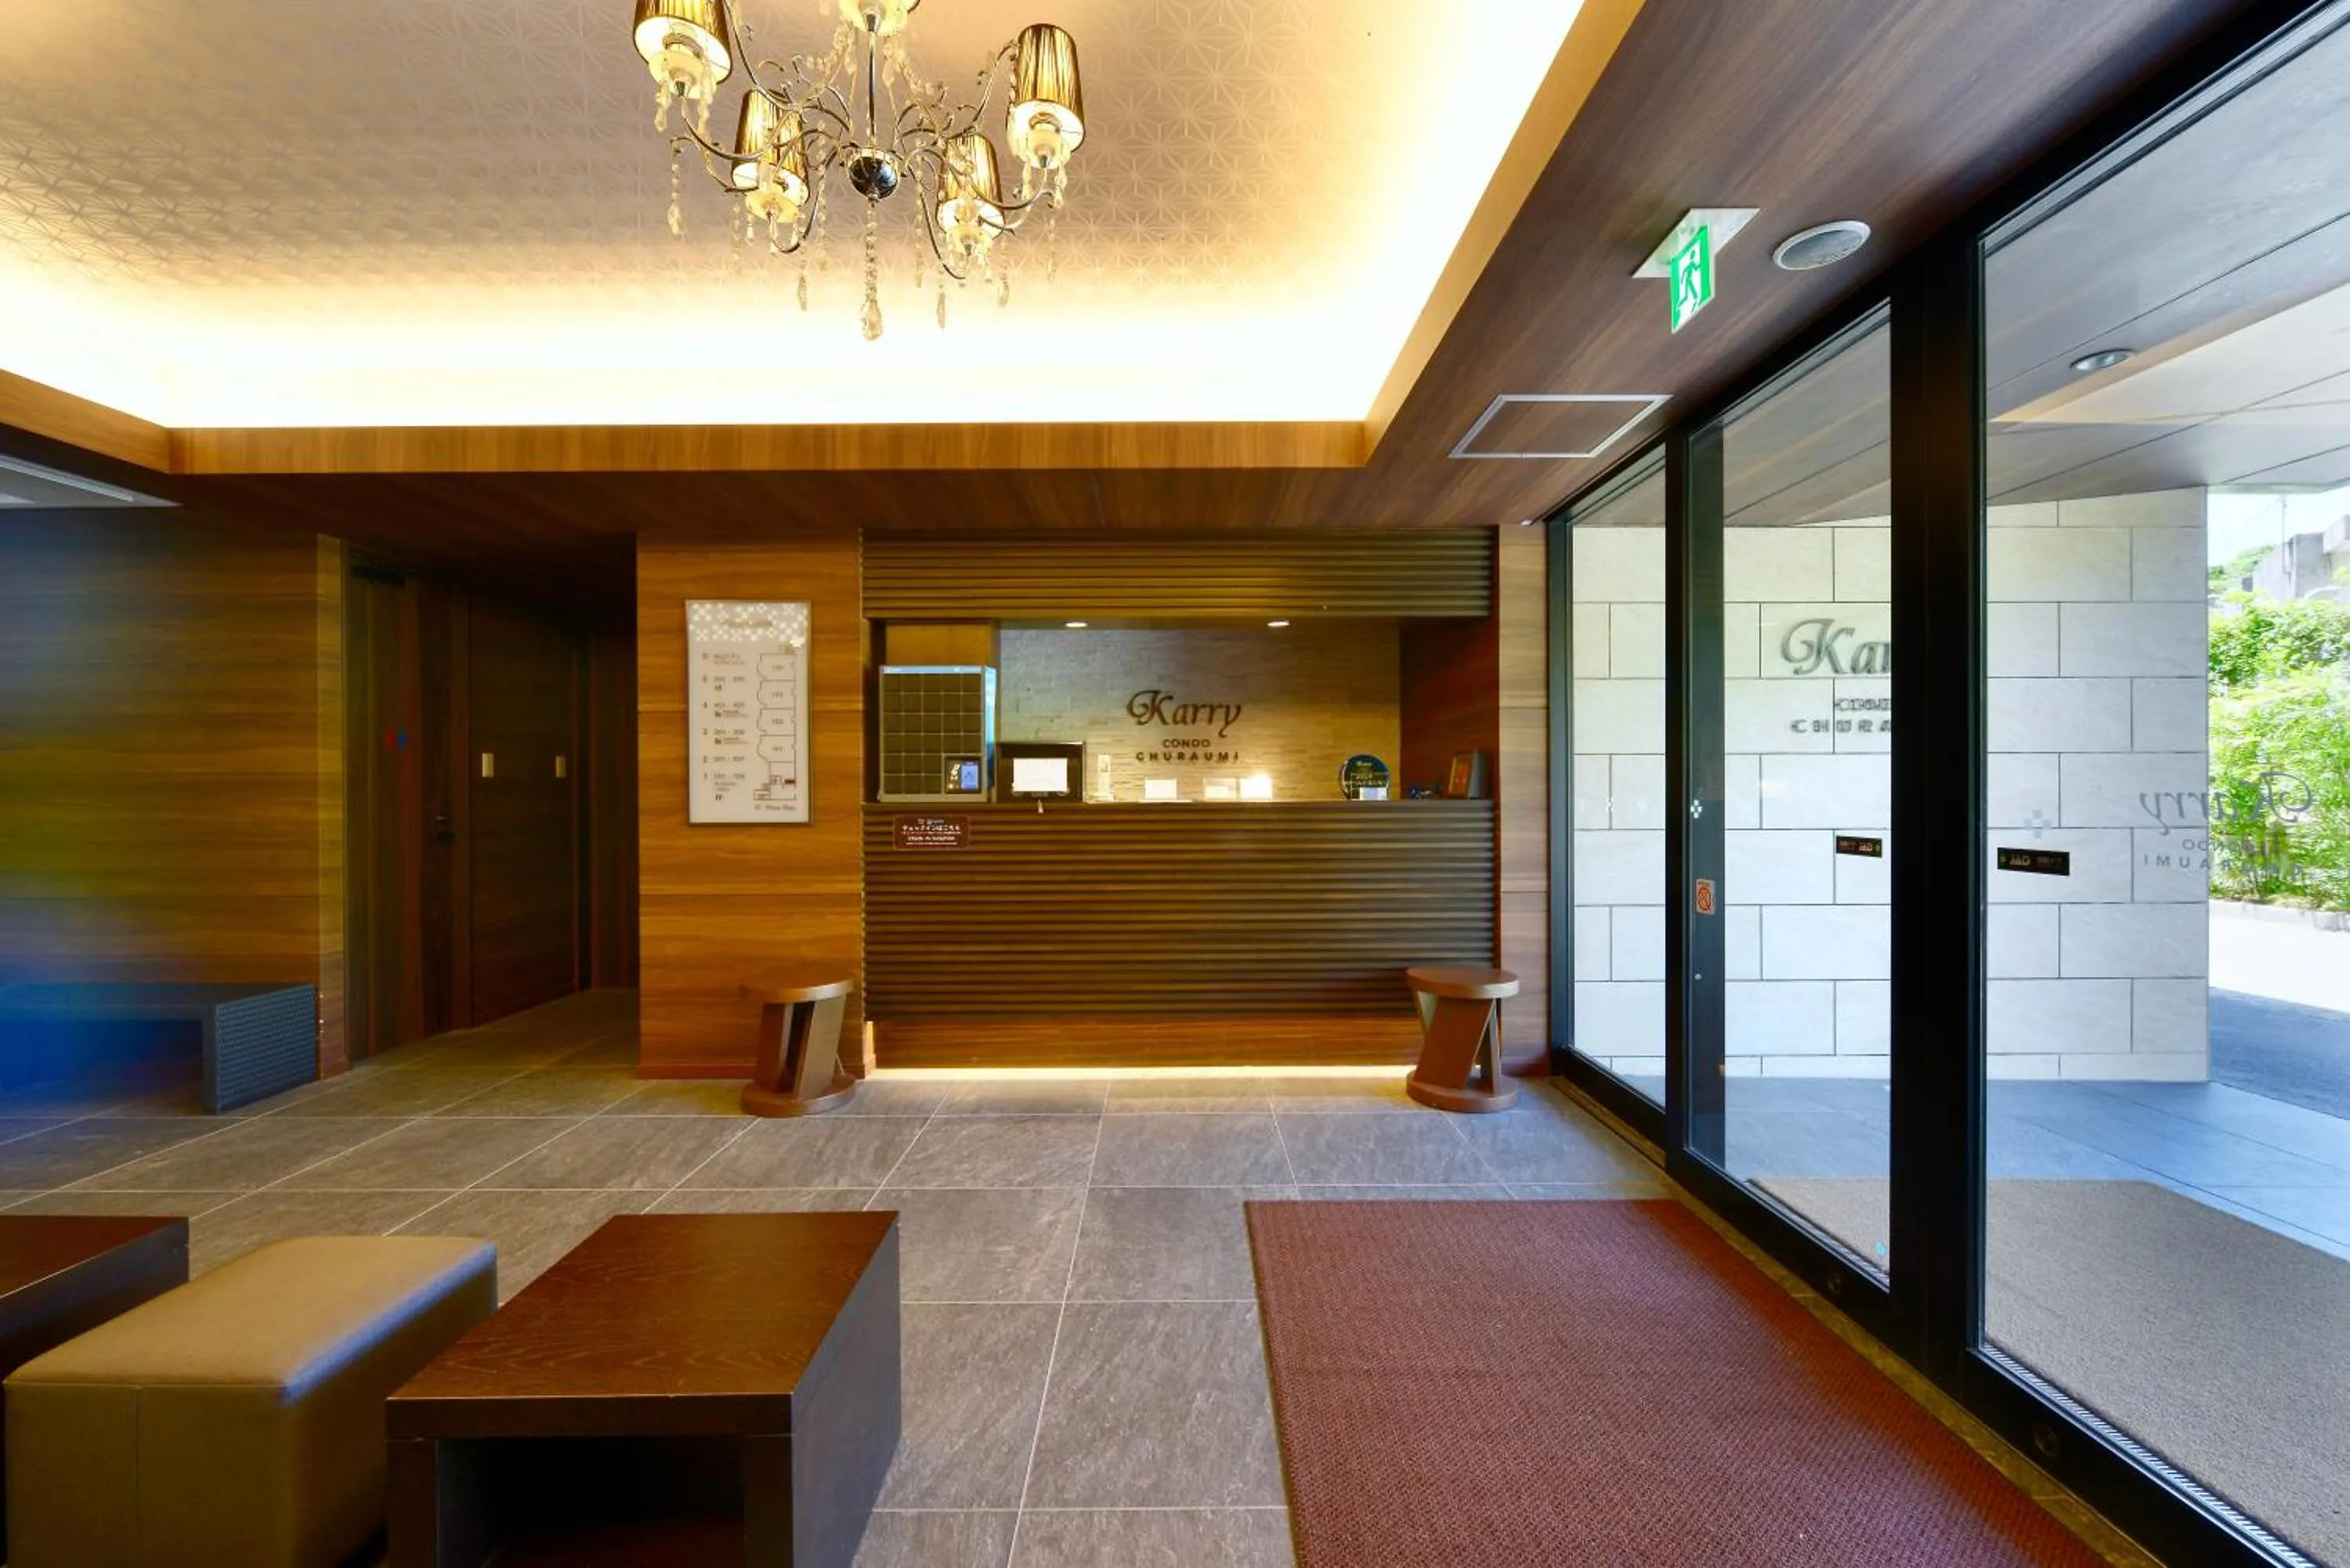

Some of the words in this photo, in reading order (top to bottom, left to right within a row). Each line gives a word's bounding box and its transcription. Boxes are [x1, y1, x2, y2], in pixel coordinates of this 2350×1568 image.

[1126, 689, 1242, 739] Karry
[1162, 739, 1211, 748] CONDO
[1136, 751, 1239, 763] CHURAUMI
